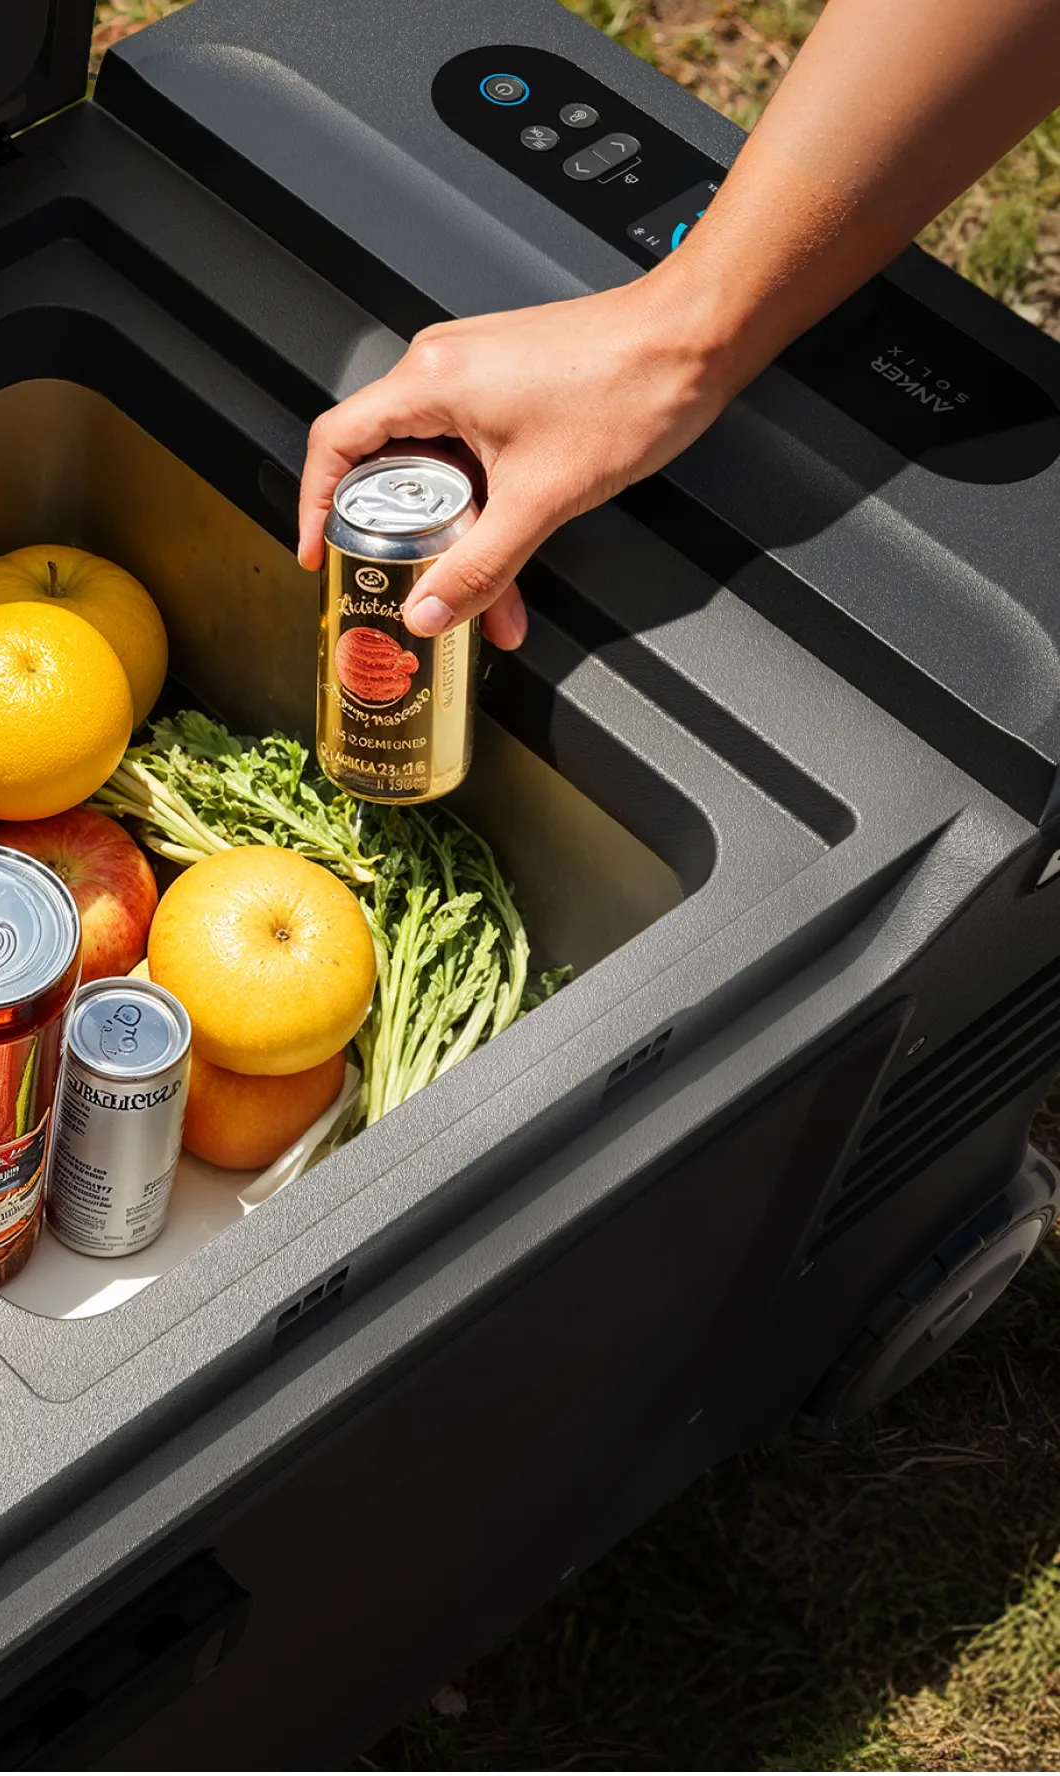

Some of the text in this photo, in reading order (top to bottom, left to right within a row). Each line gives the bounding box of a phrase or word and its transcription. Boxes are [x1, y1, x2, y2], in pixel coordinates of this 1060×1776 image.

[529, 126, 544, 138] OK
[870, 356, 955, 413] ANKER
[887, 345, 970, 403] SOLIX
